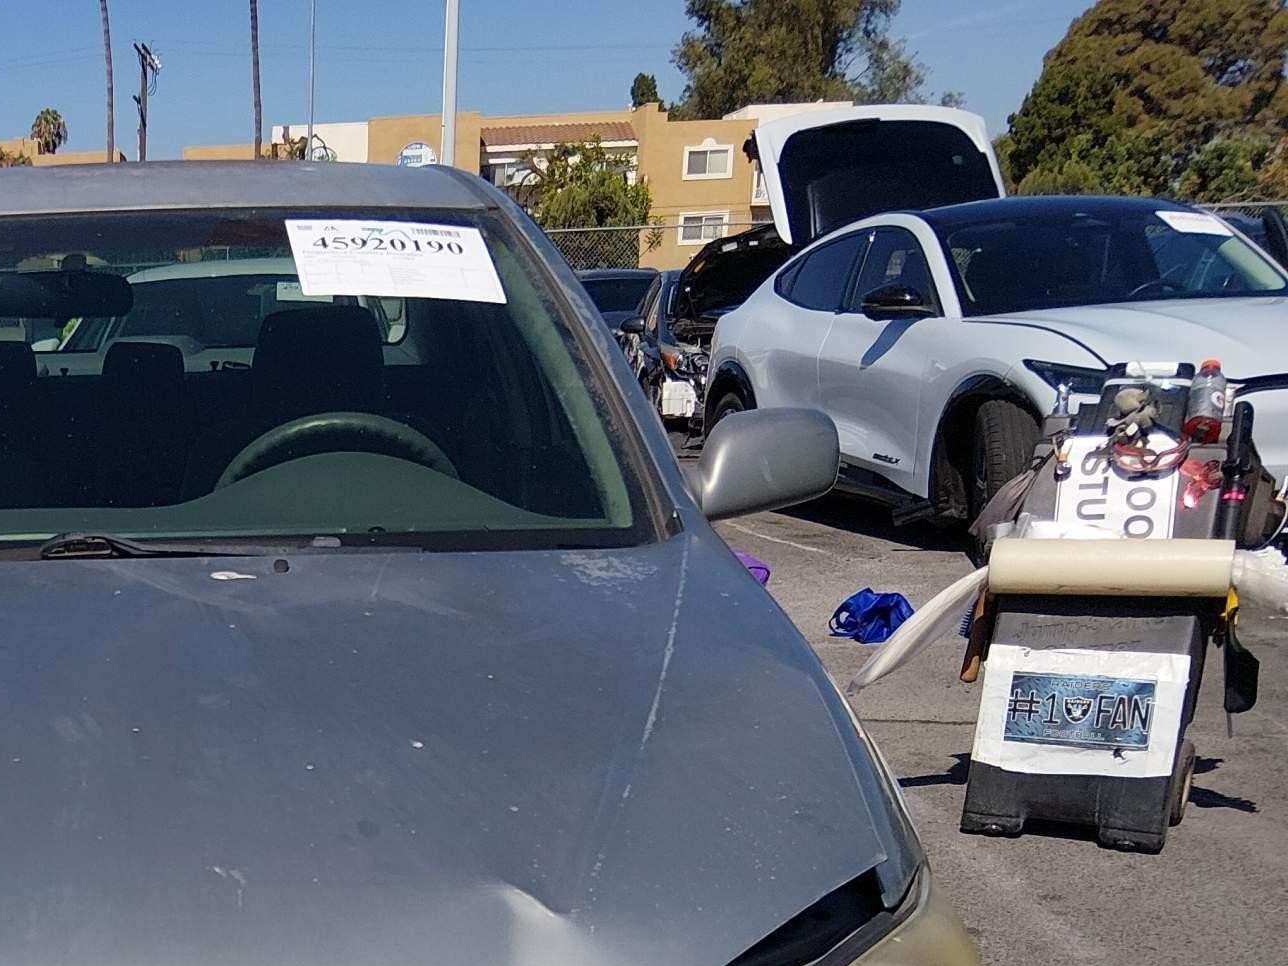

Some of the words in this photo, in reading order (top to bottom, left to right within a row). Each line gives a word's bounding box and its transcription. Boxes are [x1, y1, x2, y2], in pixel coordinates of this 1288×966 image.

[312, 236, 464, 255] 45920190
[1050, 679, 1112, 691] RAIDERS
[1008, 689, 1060, 725] #1
[1094, 693, 1152, 731] FAN
